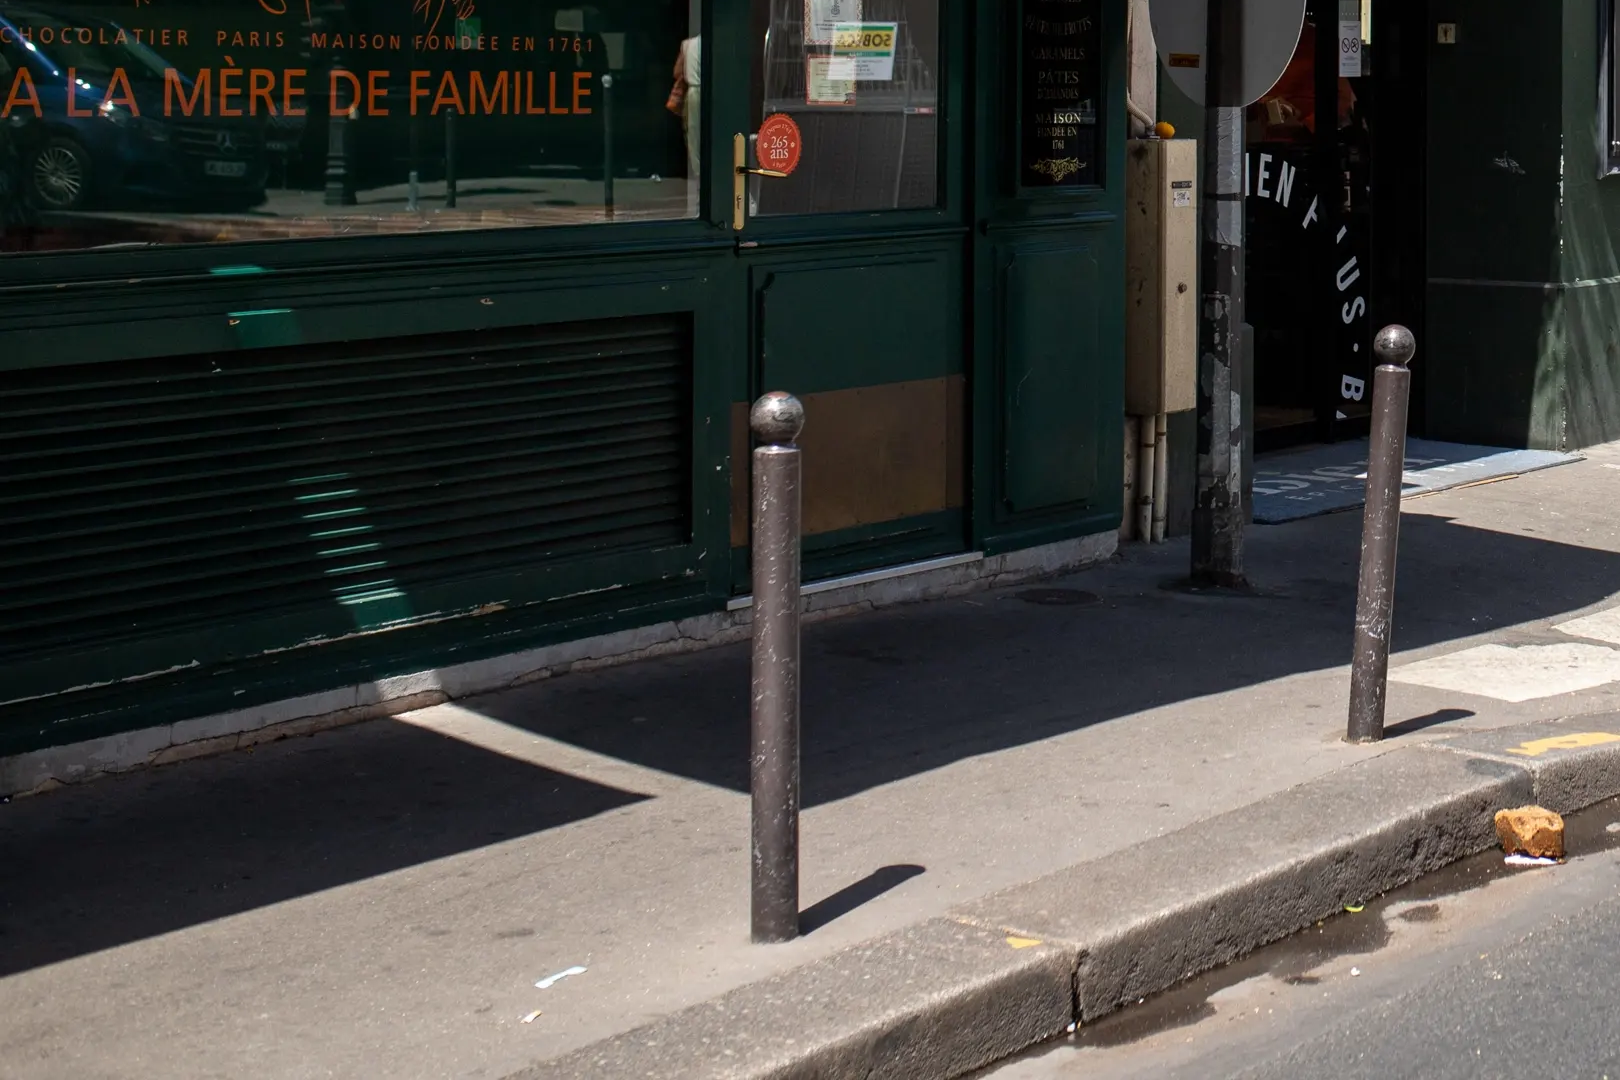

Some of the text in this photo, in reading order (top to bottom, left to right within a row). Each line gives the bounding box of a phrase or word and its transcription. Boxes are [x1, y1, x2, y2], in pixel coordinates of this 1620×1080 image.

[0, 25, 594, 54] CHOCOLATIER PARIS MAISON FONDÉE EN 1761
[1, 54, 594, 119] A LA MÈRE DE FAMILLE
[1034, 112, 1081, 125] MAISON
[1066, 125, 1077, 137] EN
[771, 136, 788, 149] 265
[770, 148, 789, 159] ans
[1245, 152, 1296, 208] IEN
